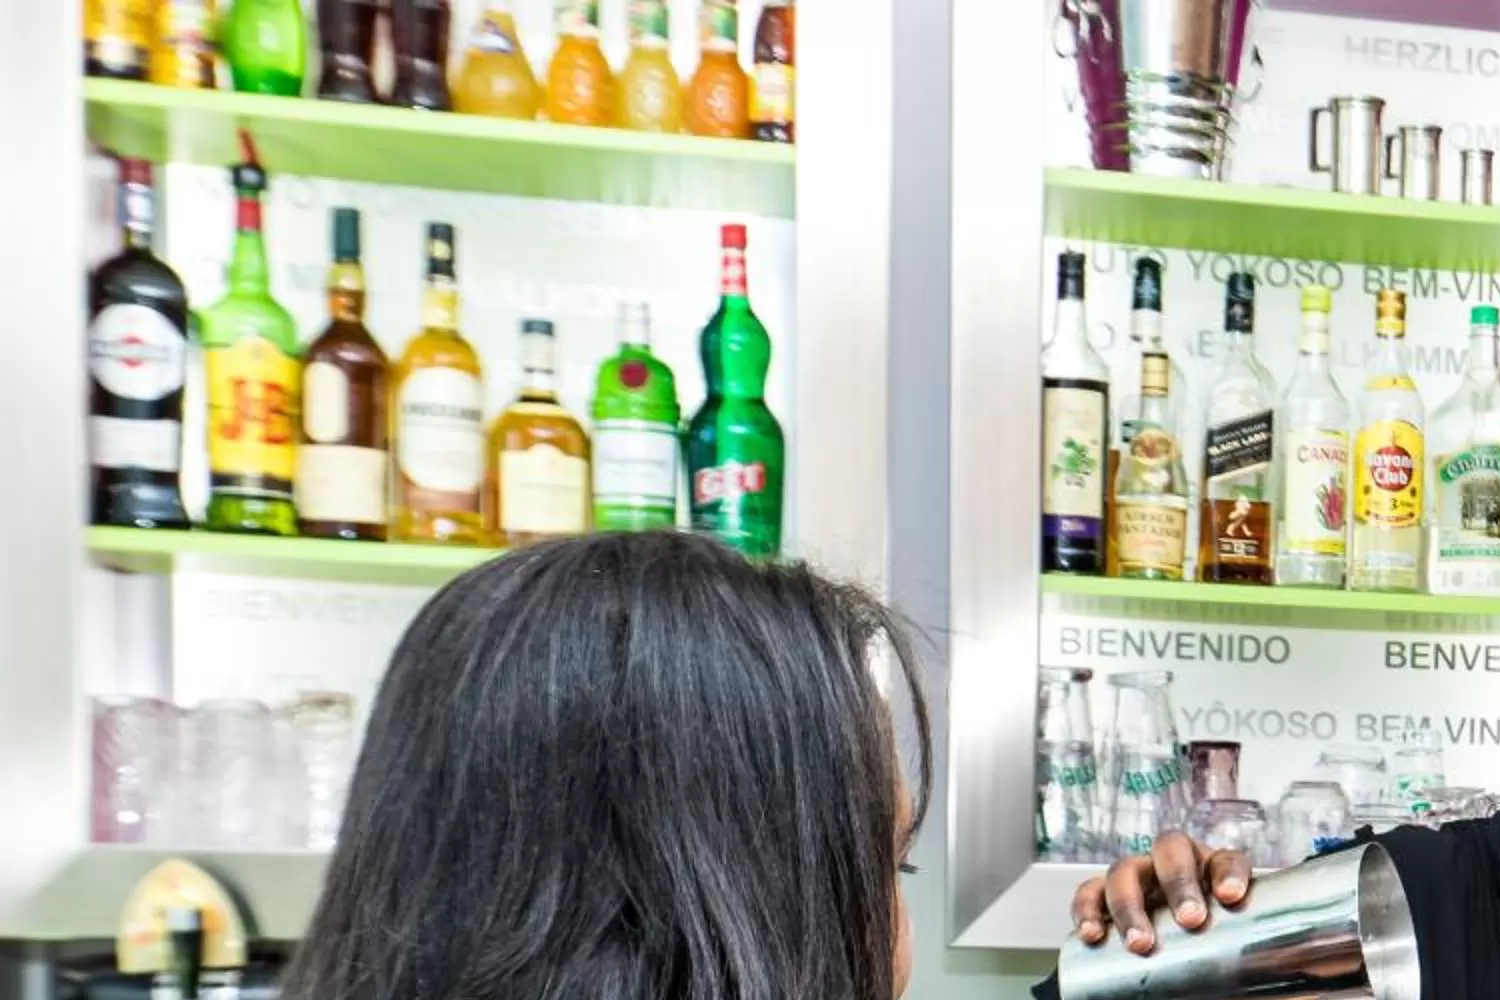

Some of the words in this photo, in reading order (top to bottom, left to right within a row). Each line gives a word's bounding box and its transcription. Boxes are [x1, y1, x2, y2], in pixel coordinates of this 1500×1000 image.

[1375, 467, 1409, 485] Club
[1060, 626, 1291, 665] BIENVENIDO
[1180, 701, 1338, 741] YÔKOSO
